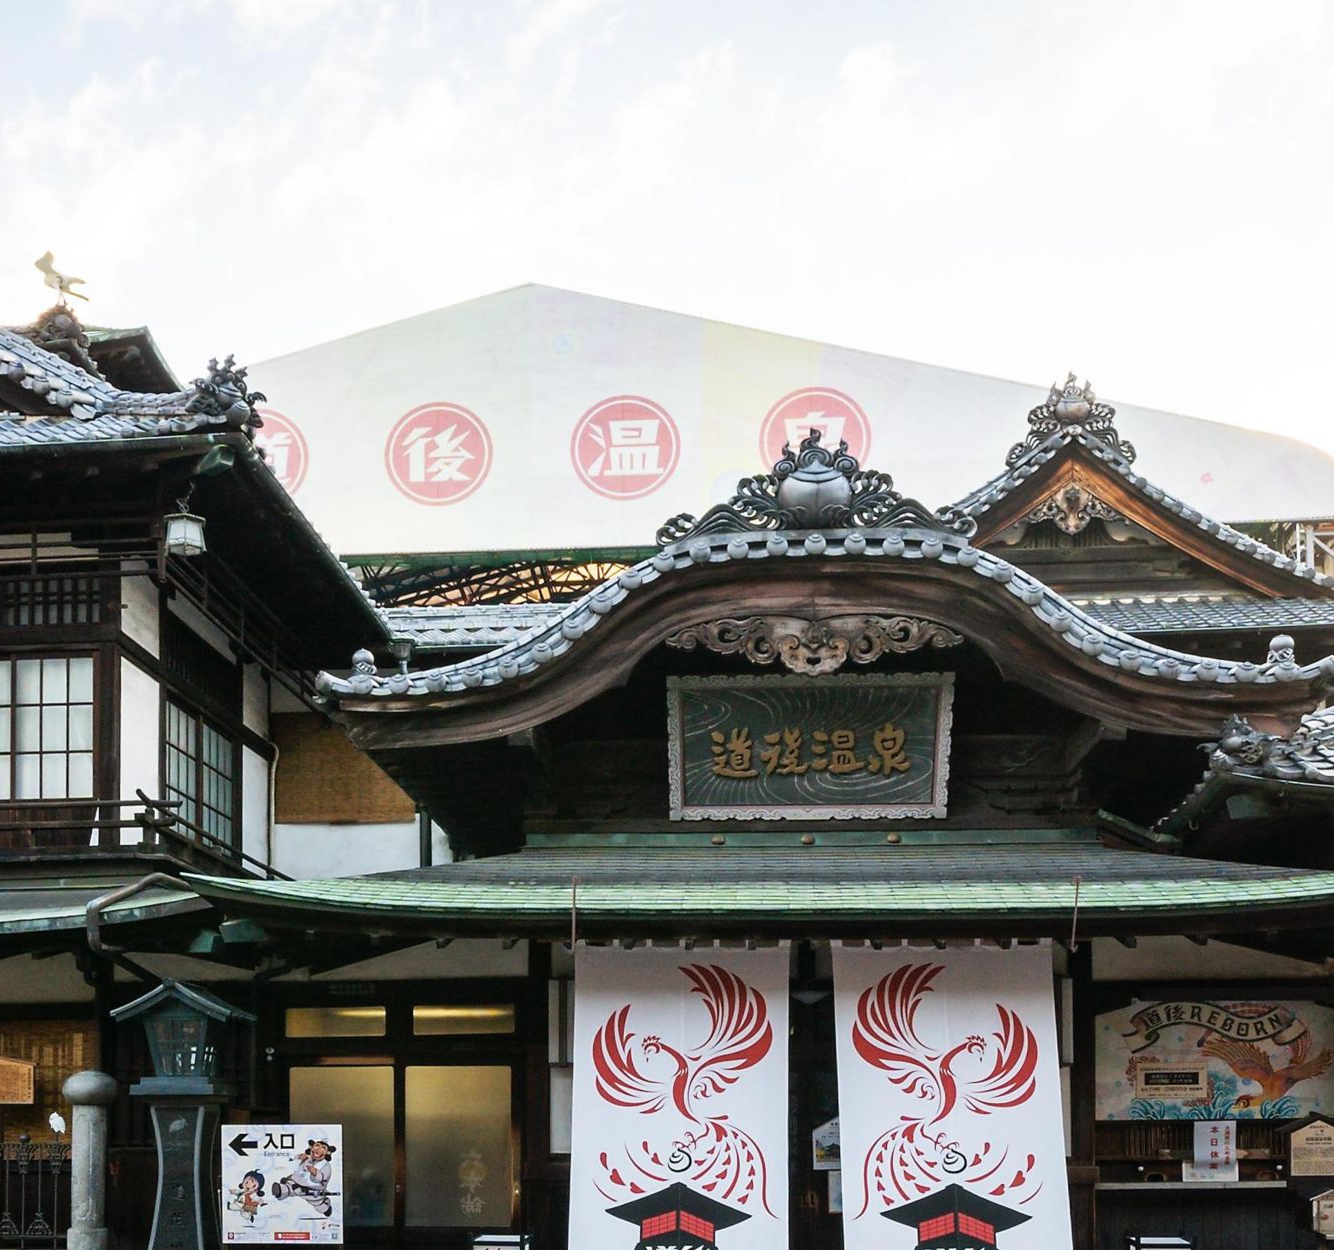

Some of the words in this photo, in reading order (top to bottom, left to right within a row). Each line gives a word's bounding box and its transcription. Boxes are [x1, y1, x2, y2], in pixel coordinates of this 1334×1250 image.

[711, 723, 910, 778] 道後温泉
[263, 1133, 295, 1150] 入口
